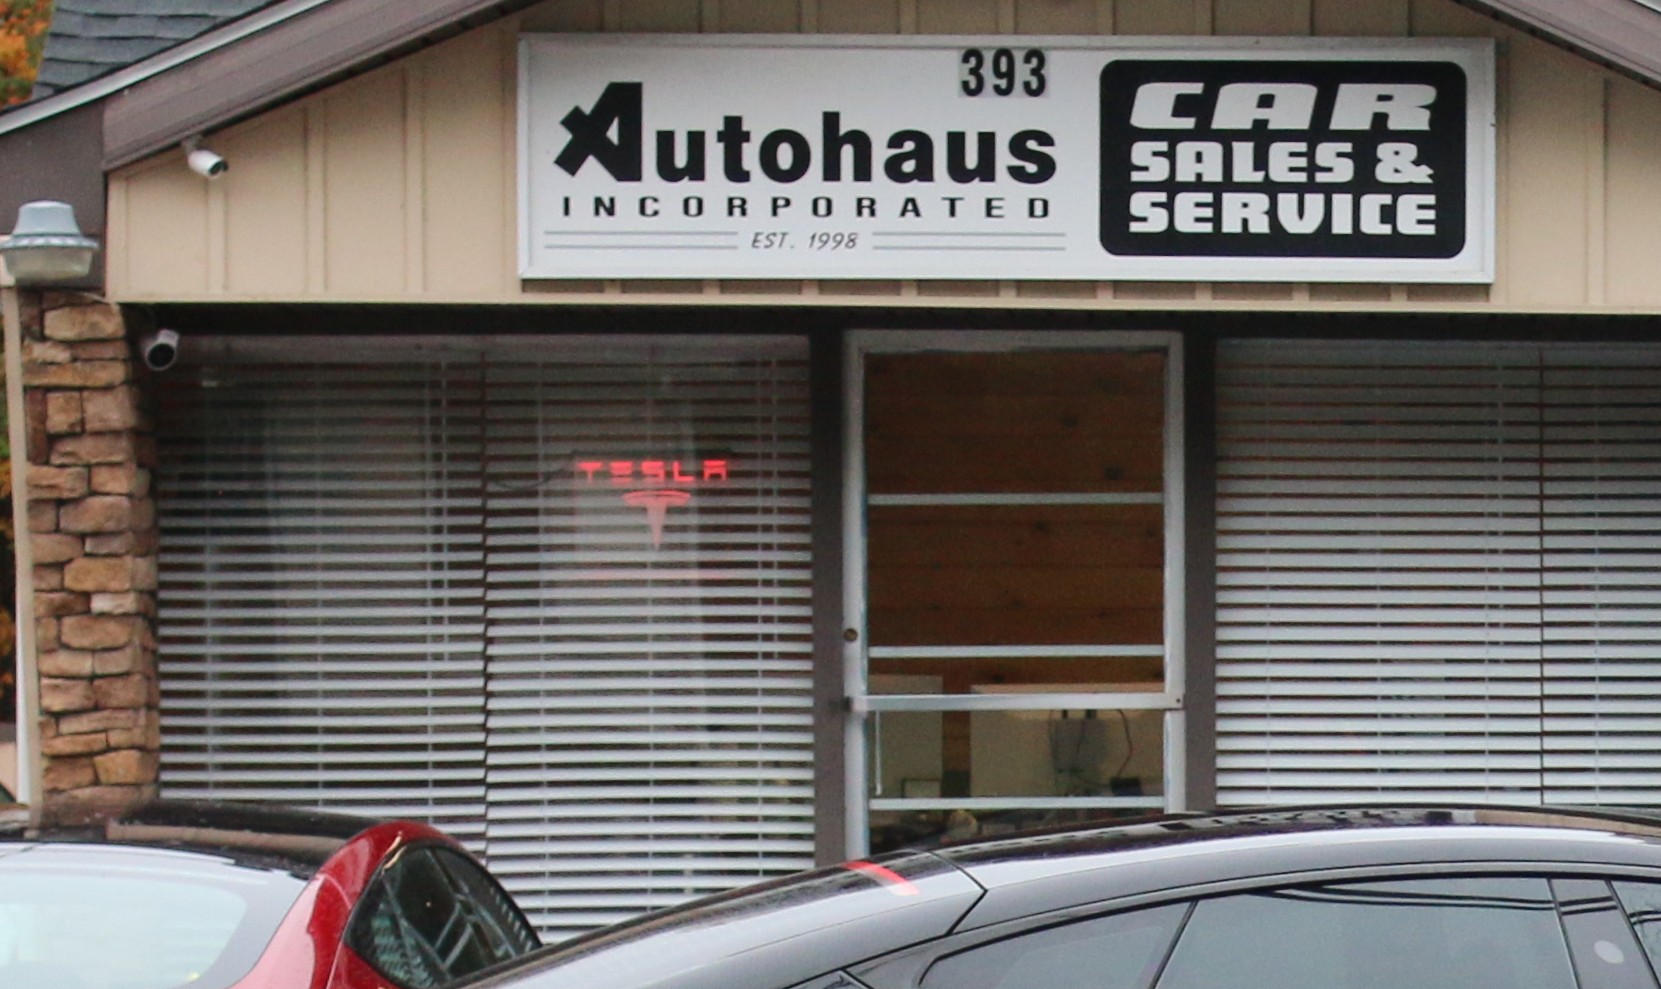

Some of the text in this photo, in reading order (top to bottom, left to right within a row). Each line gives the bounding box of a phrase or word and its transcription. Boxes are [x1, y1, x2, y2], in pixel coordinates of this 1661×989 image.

[961, 48, 1047, 96] 393
[1130, 82, 1437, 130] CAR
[554, 82, 1057, 183] Autohaus
[1130, 141, 1434, 183] SALES &
[562, 195, 1051, 219] INCORPORATED
[1130, 192, 1437, 236] SERVICE
[750, 231, 859, 251] EST. 1998
[578, 460, 728, 483] TESLA
